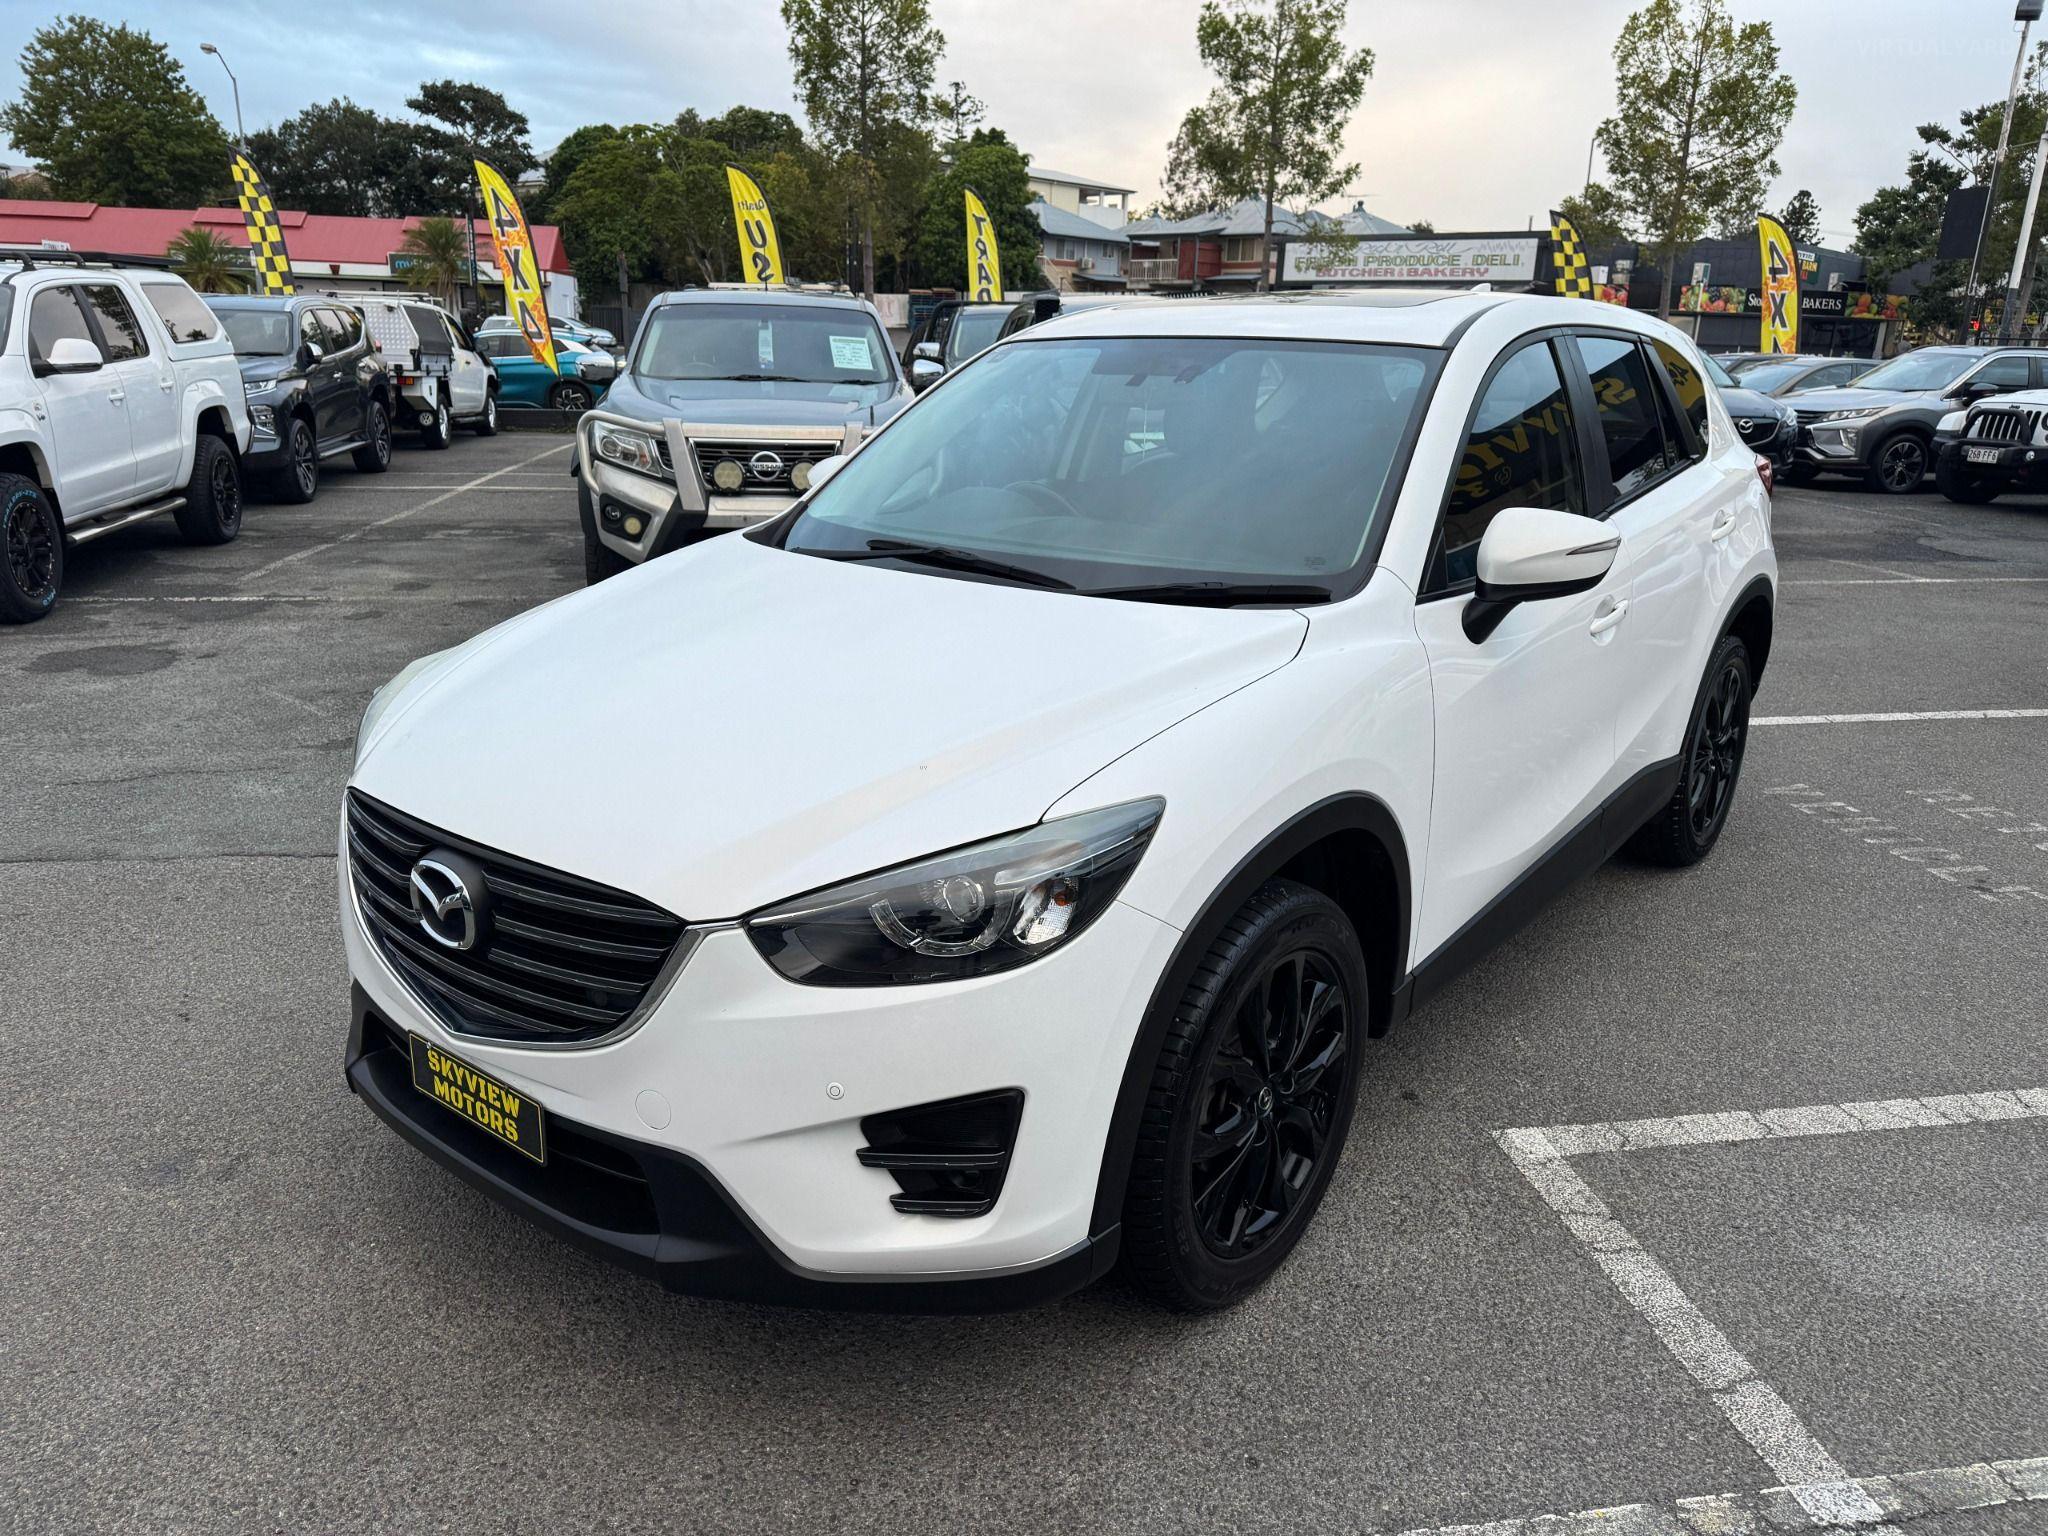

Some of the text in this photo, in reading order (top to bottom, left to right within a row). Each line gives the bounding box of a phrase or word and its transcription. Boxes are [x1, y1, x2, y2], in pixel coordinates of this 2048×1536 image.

[1407, 267, 1490, 277] BAKERY
[1802, 297, 1842, 310] BAKERS
[427, 1050, 520, 1118] SKYVIEW
[433, 1075, 519, 1143] MOTORS
